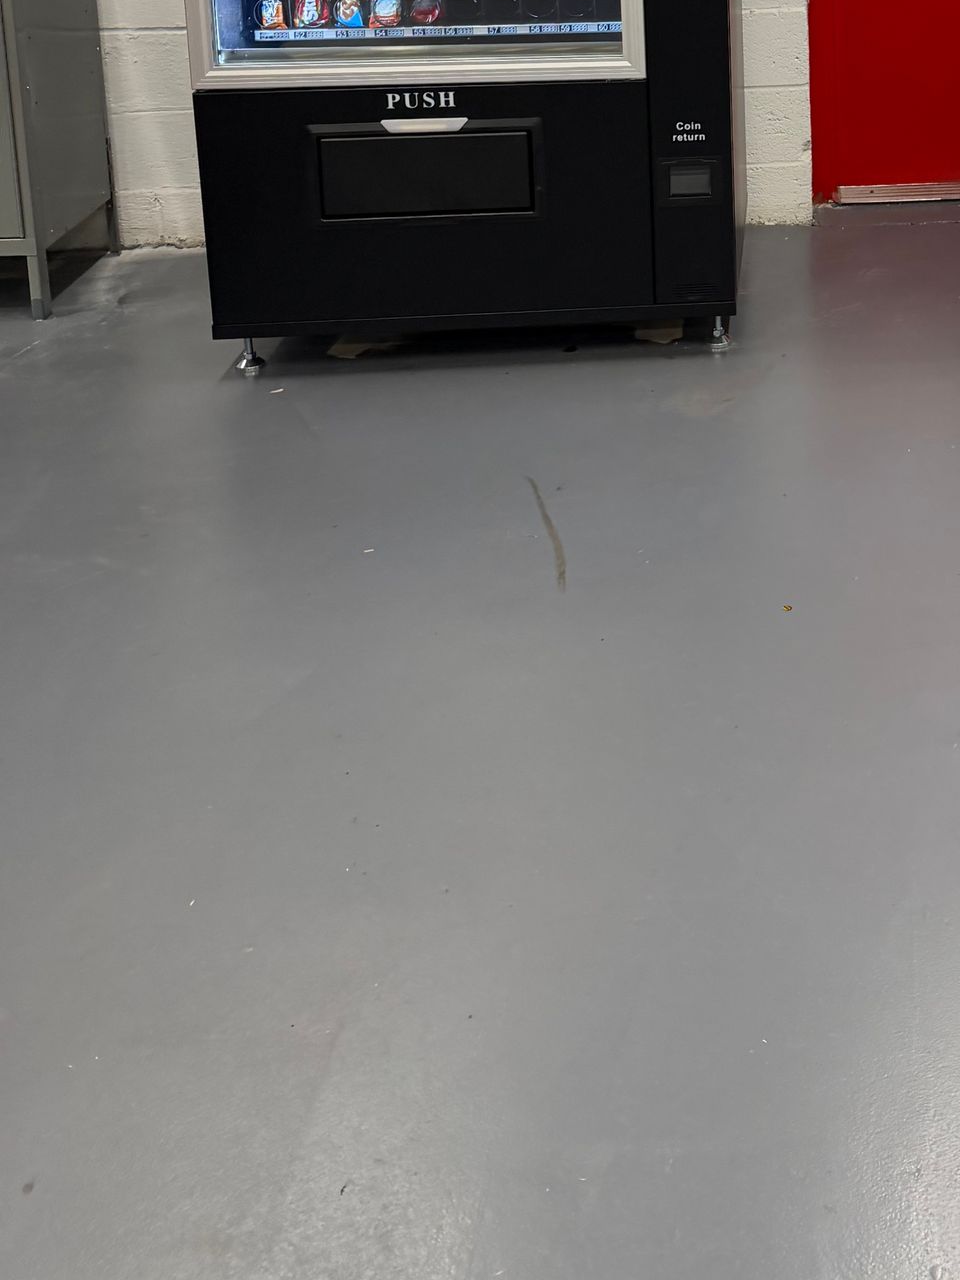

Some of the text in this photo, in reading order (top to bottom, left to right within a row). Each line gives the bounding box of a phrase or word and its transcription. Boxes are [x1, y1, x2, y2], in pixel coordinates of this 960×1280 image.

[386, 91, 456, 109] PUSH
[676, 121, 701, 131] Coin
[672, 132, 706, 142] return
